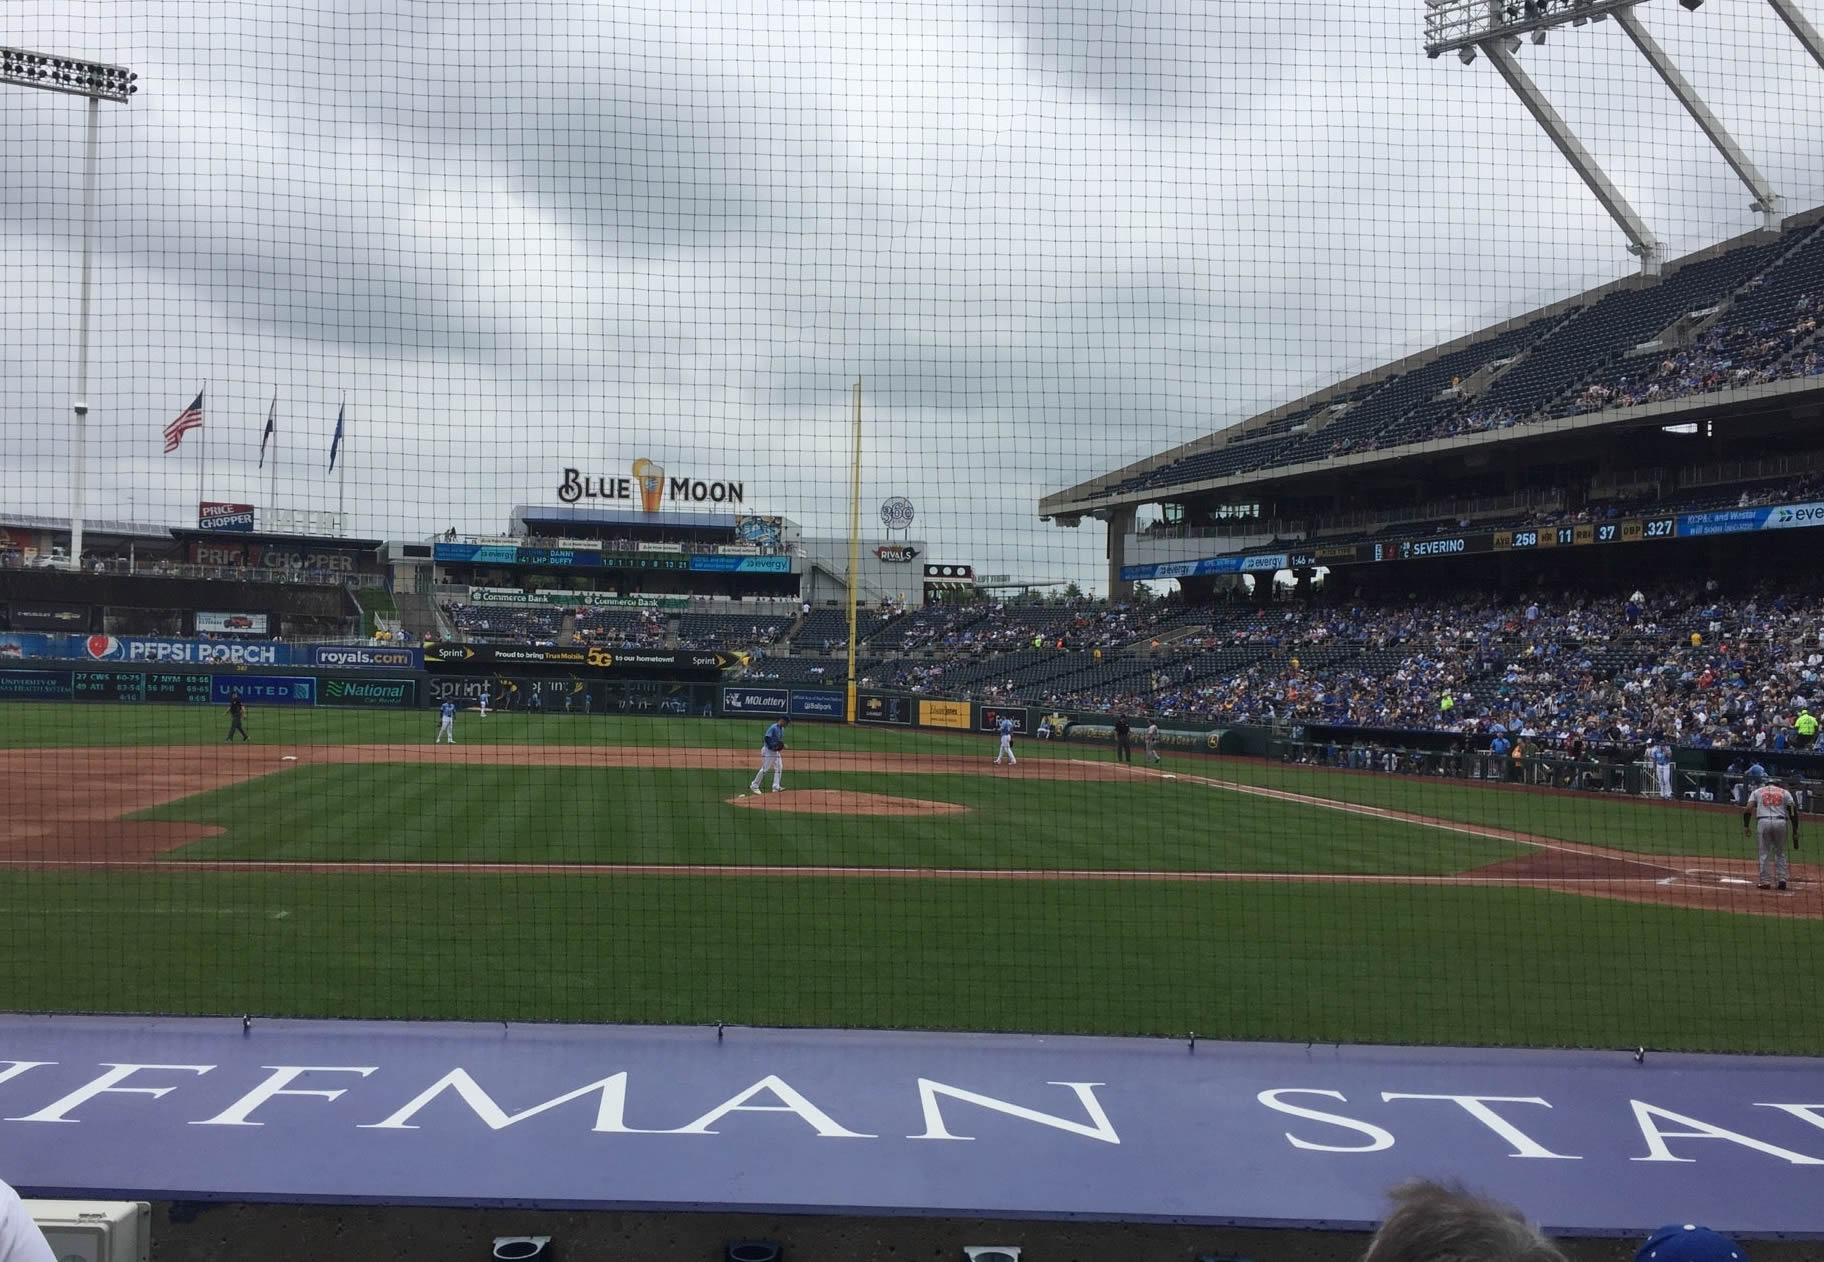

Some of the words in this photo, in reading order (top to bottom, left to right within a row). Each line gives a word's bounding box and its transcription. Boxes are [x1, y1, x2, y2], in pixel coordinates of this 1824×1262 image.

[558, 467, 631, 504] BLUE
[670, 476, 744, 504] MOON
[202, 505, 234, 516] PRICE
[201, 514, 252, 528] CHOPPER
[1511, 532, 1536, 548] .258
[1558, 529, 1572, 543] 11
[1599, 525, 1616, 540] 37
[1643, 520, 1673, 537] .327
[1413, 538, 1465, 555] SEVERINO
[264, 551, 353, 571] CHOPPER
[489, 551, 515, 561] evergy
[881, 551, 912, 560] RIVALS
[1291, 555, 1306, 566] 1:46
[754, 560, 787, 571] evergy
[1255, 556, 1284, 569] evergy
[482, 592, 527, 603] Commerce
[528, 594, 549, 604] Bank
[594, 596, 637, 607] Commerce
[638, 599, 659, 608] Bank
[129, 641, 191, 661] PEPSI
[198, 643, 276, 664] PORCH
[320, 649, 409, 665] royals.com
[438, 648, 463, 659] Sprint
[495, 650, 516, 659] Proud
[517, 651, 525, 659] to
[525, 651, 544, 660] bring
[586, 646, 613, 667] 5G
[615, 655, 623, 663] to
[636, 655, 675, 664] hometown!
[692, 656, 716, 666] Sprint
[90, 673, 110, 681] CWS
[161, 675, 181, 683] NYM
[219, 684, 290, 697] UNITED
[344, 682, 405, 698] National
[430, 677, 492, 699] Sprint
[744, 695, 786, 709] MOLottery
